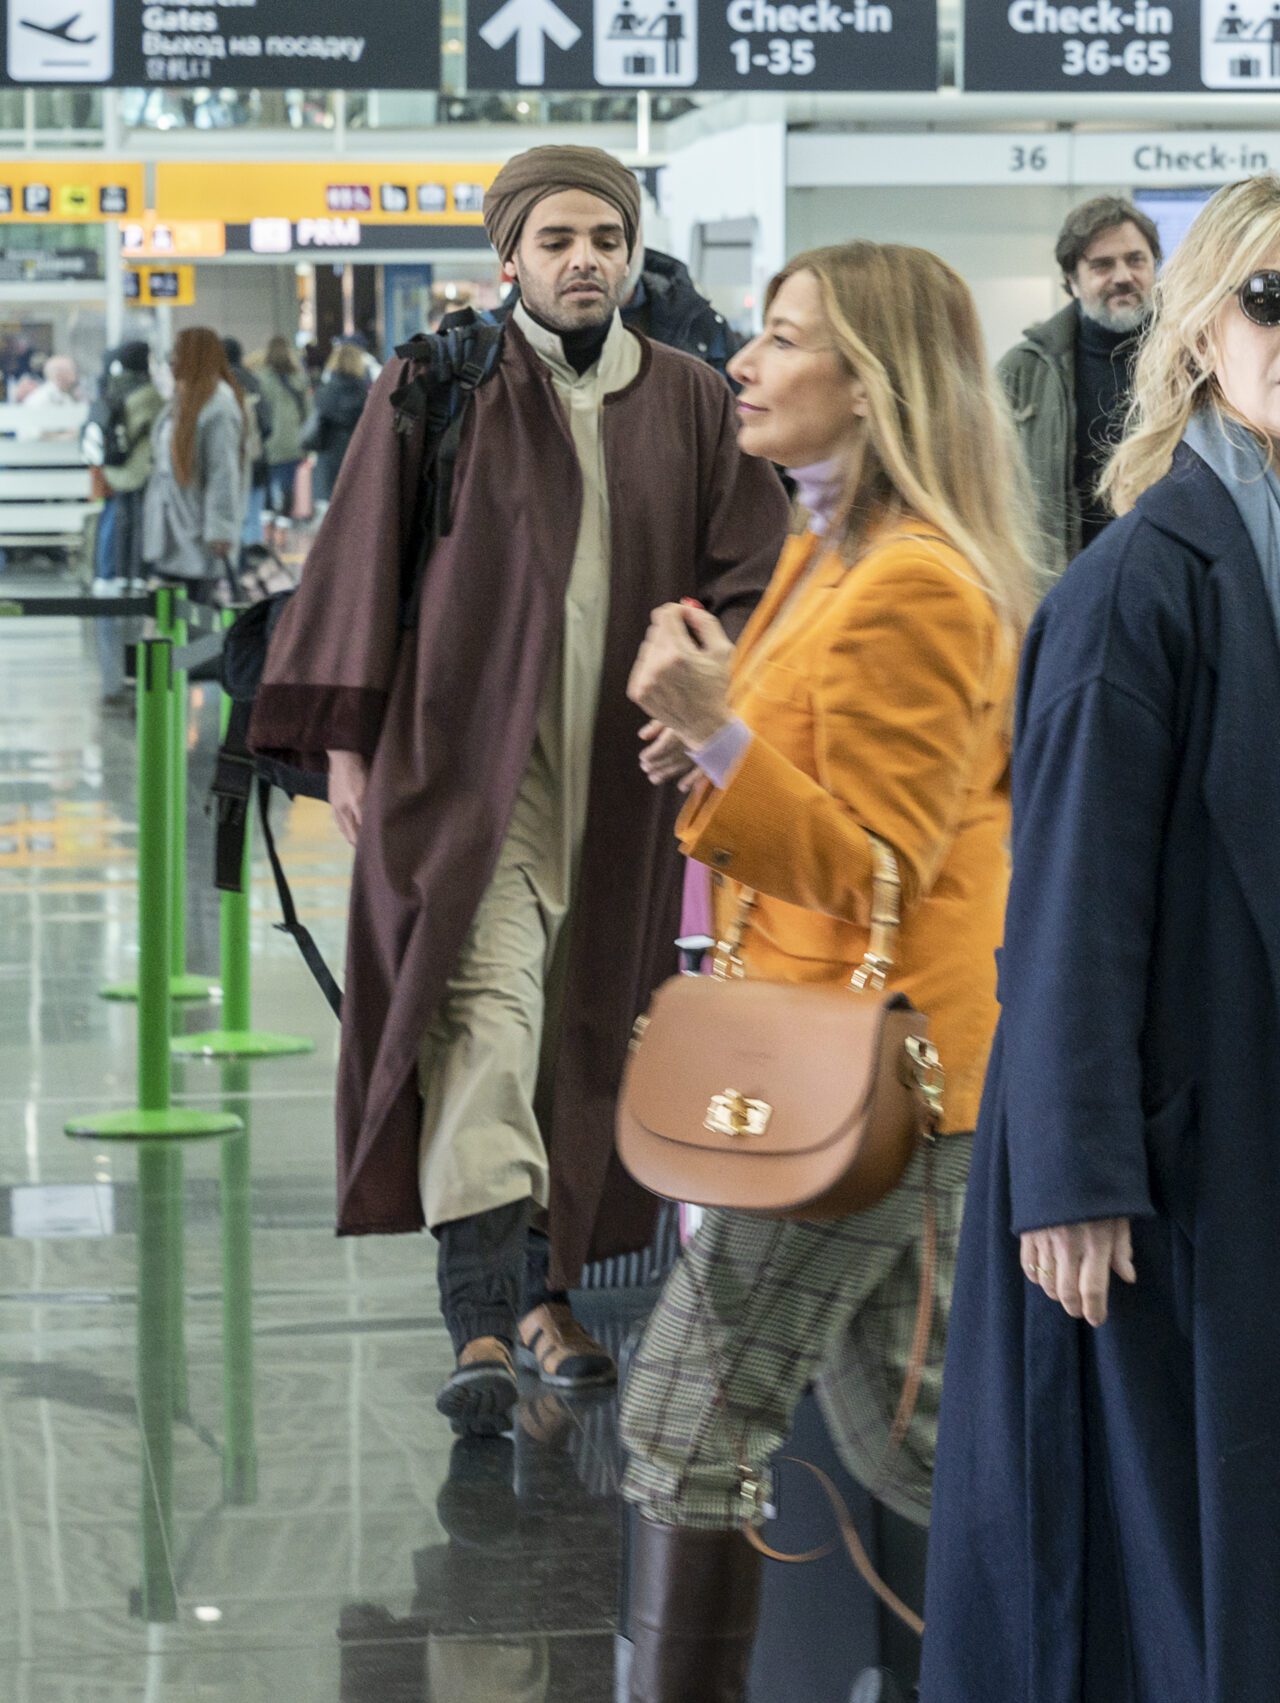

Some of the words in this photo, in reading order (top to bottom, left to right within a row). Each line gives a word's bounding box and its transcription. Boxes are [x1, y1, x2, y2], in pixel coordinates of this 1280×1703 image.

[142, 6, 217, 32] Gates
[726, 0, 893, 33] Check-in
[1007, 0, 1173, 34] Check-in
[729, 38, 816, 75] 1-35
[1061, 39, 1172, 76] 36-65
[1009, 145, 1047, 171] 36
[1133, 145, 1269, 171] Check-in
[297, 217, 361, 246] PRM
